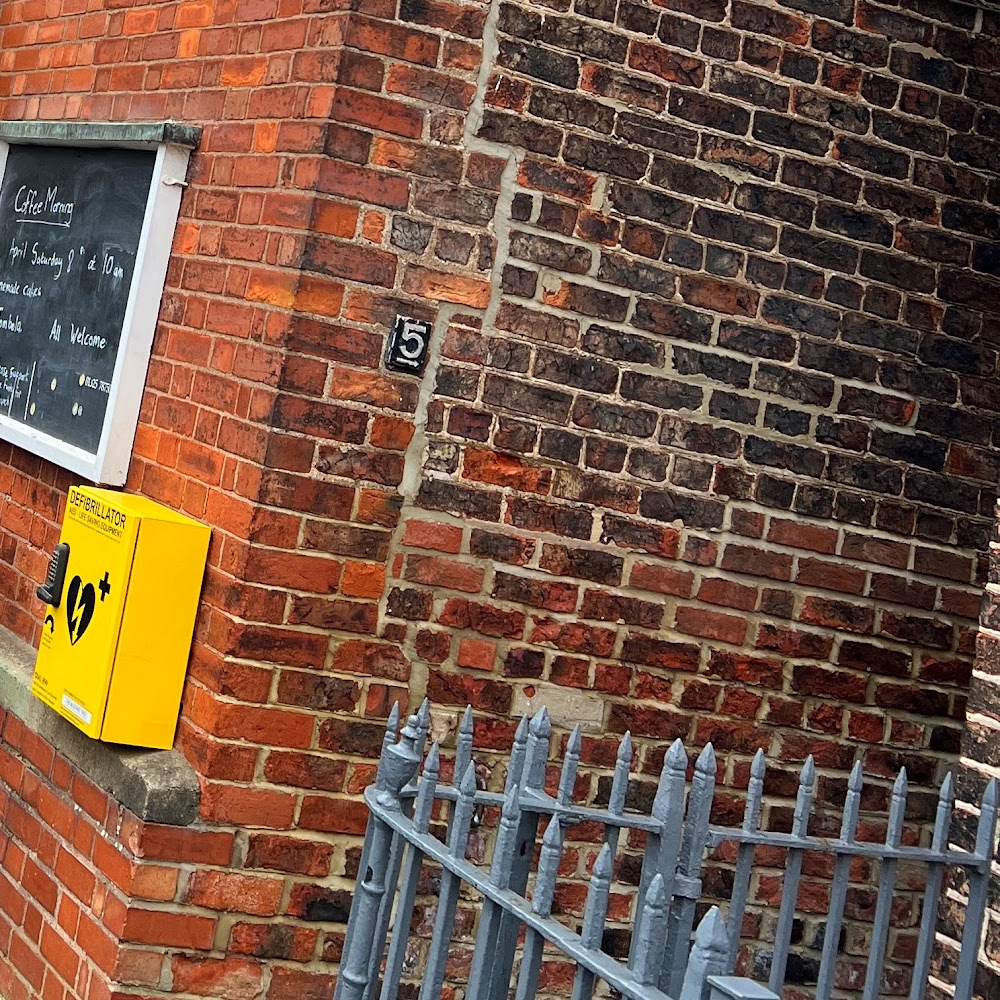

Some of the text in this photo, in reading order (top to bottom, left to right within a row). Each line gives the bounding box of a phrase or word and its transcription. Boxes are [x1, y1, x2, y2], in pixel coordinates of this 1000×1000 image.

[14, 184, 75, 225] Coffee Morning
[9, 237, 28, 266] April
[31, 241, 63, 281] Saturday
[48, 318, 106, 350] All Welcome
[400, 322, 427, 359] 5
[70, 490, 126, 529] DEFIBRILLATOR
